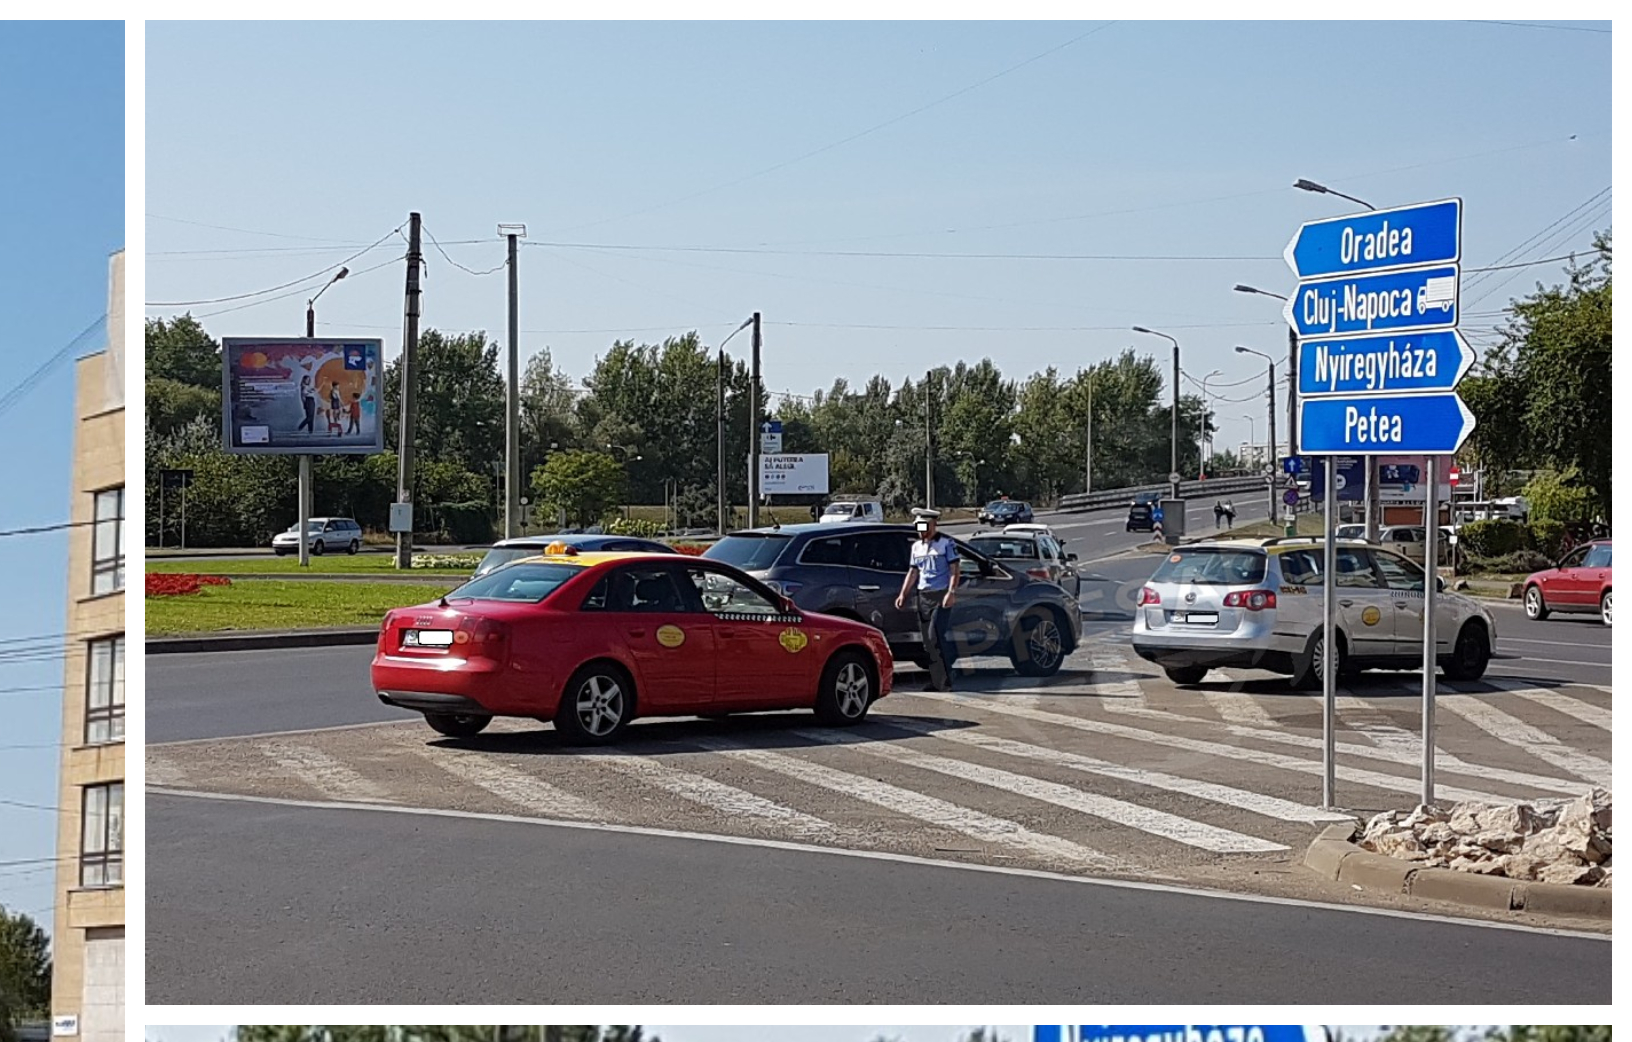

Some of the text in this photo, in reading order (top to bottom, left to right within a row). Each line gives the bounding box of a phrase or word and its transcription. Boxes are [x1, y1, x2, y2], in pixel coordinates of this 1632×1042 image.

[1340, 220, 1412, 264] Oradea
[1303, 283, 1412, 333] Cluj-Napoca
[1344, 405, 1402, 444] Petea
